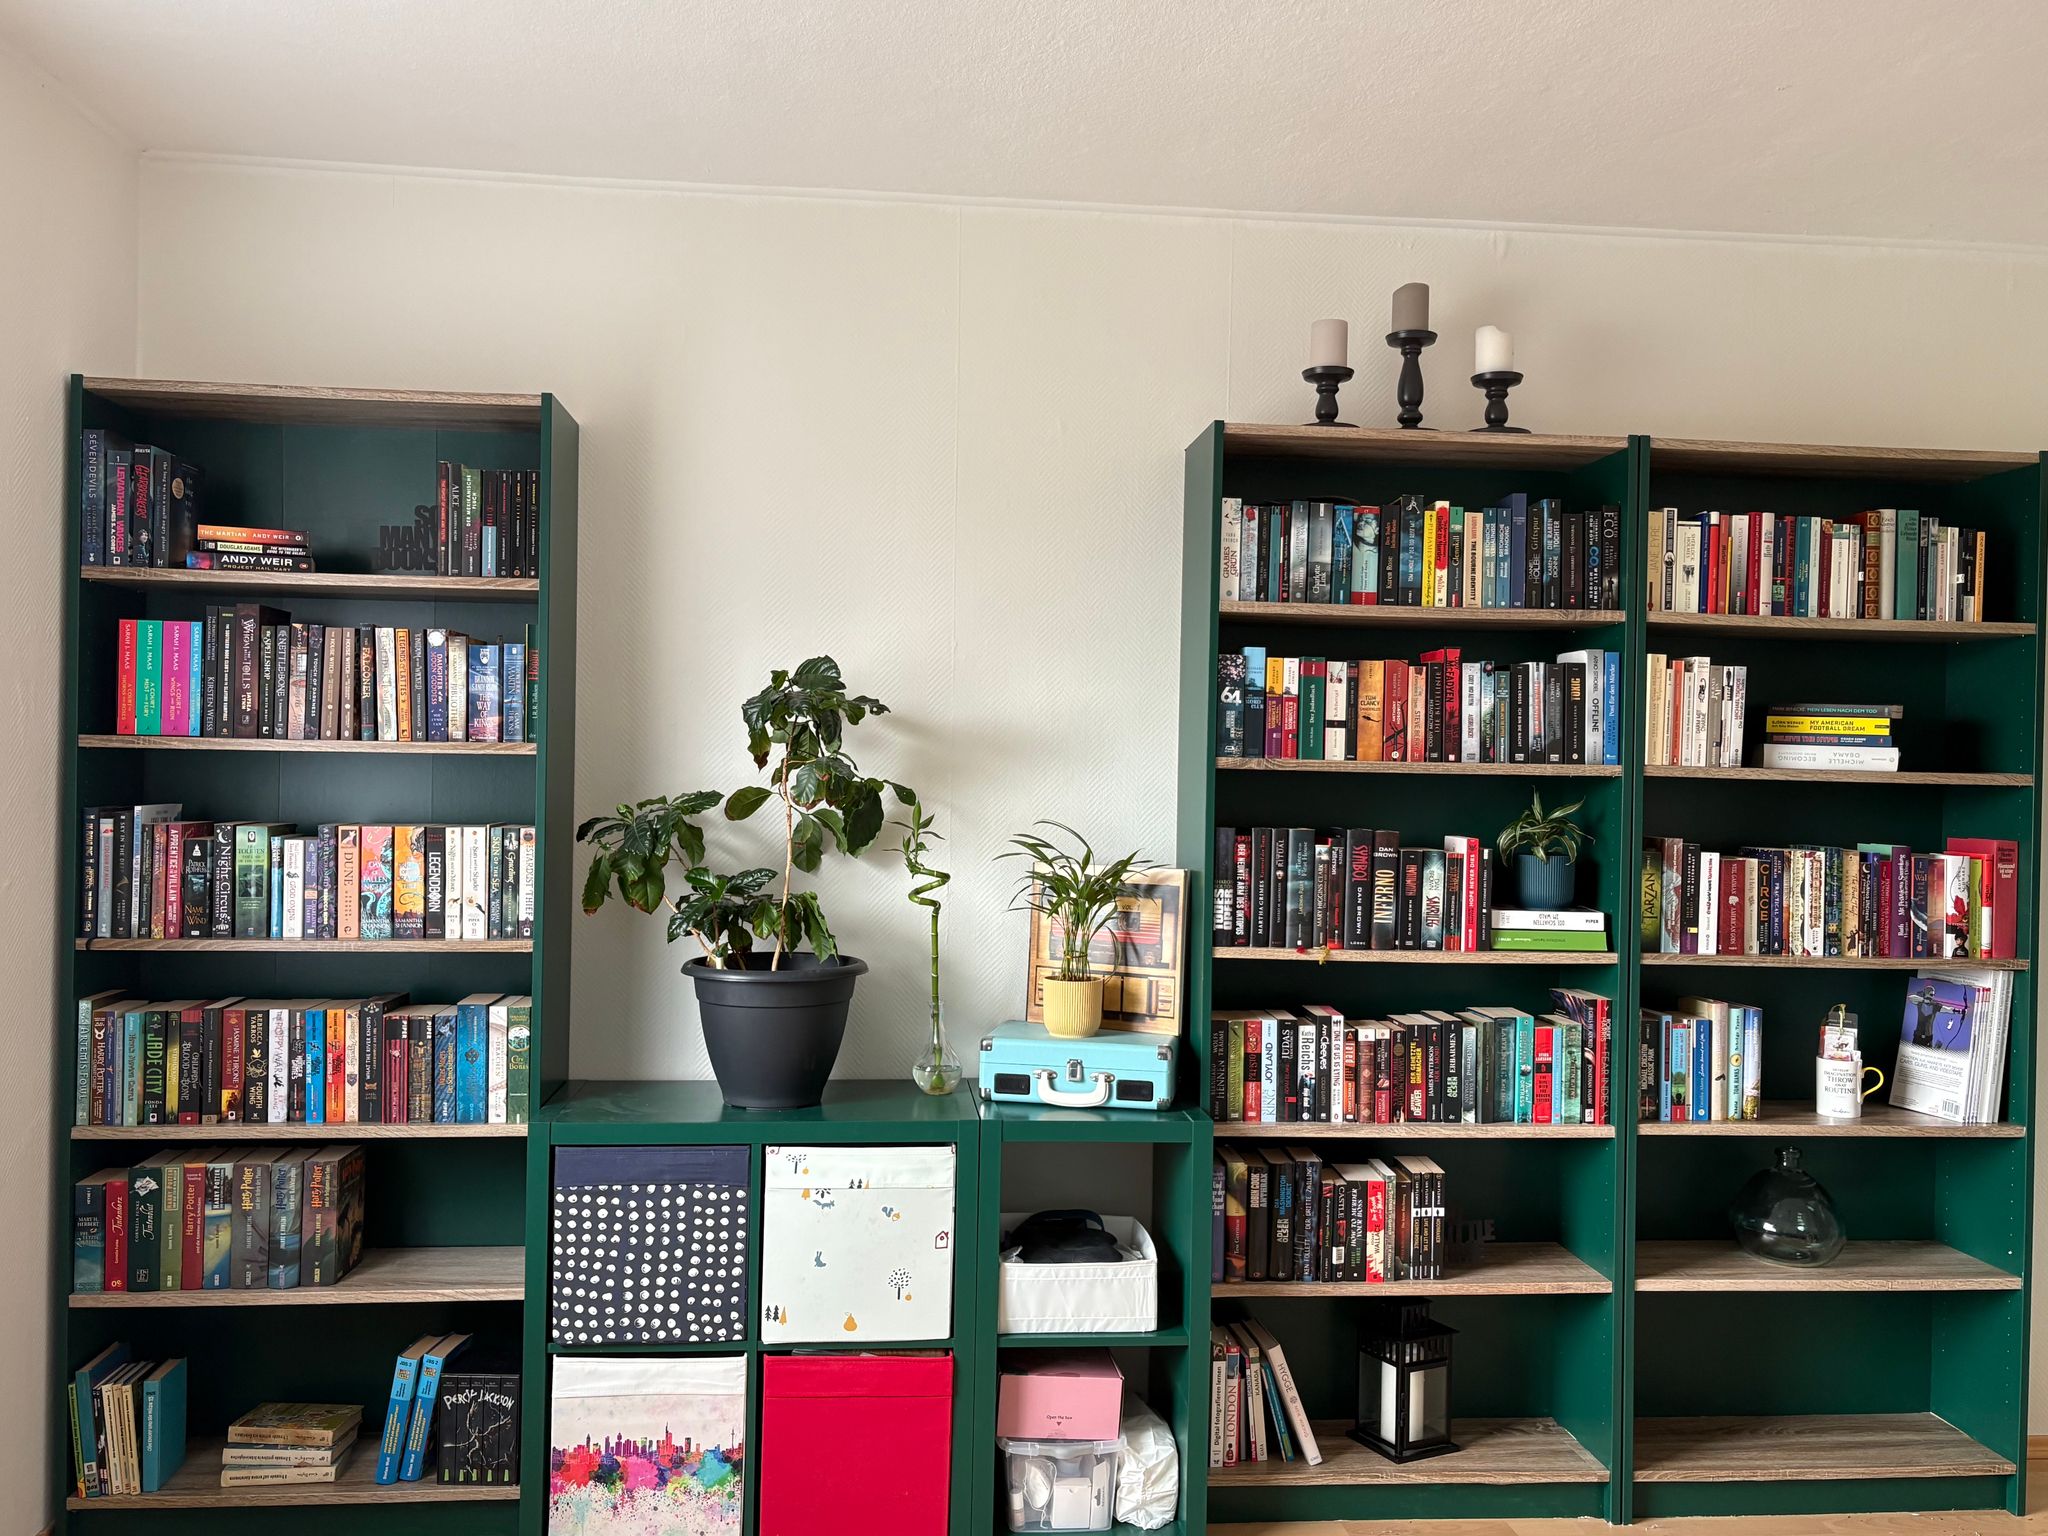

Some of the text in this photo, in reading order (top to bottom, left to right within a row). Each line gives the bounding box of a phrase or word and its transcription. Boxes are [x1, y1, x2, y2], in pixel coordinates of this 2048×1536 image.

[89, 434, 98, 499] SEVEN DEVILS
[116, 466, 126, 553] LEVIATHAN WAKES
[134, 464, 150, 519] GEARBREAKERS
[452, 484, 460, 507] ALICE
[216, 530, 247, 538] MARTIAN
[1530, 516, 1541, 551] Giftspur
[1603, 512, 1614, 538] ECO
[219, 543, 243, 551] DOUGLAS
[221, 555, 293, 567] ANDY WEIR
[1222, 546, 1231, 579] GRABES
[1452, 535, 1461, 566] Glennkill
[1312, 564, 1322, 594] Charlotte
[1319, 572, 1327, 588] Link
[1532, 554, 1541, 584] HOLBE
[264, 637, 272, 681] SPELLSHOP
[277, 638, 287, 672] NETTLE
[361, 647, 371, 699] FALCONER
[1220, 686, 1241, 704] 64
[1445, 660, 1454, 704] McFADYEN
[1570, 677, 1581, 702] TOXIC
[207, 676, 215, 732] KIRSTEN WEISS
[1592, 697, 1600, 733] OFFLINE
[1413, 710, 1421, 750] STEVE BERRY
[169, 829, 179, 901] APPRENTICE VILLAIN
[343, 852, 354, 886] DUNE
[491, 836, 500, 893] SKIN SEA
[503, 851, 516, 884] Graceling
[1277, 839, 1285, 868] RITUAL
[1331, 847, 1340, 876] Patterson
[1352, 844, 1369, 883] SYMBOL
[219, 846, 232, 919] Night Circus
[428, 852, 442, 913] LEGENDBORN
[524, 847, 533, 916] STARDUST THIEF
[1235, 843, 1246, 936] DER NEUNTE ARM DES OKTOPUS
[1373, 869, 1395, 925] INFERNO
[1643, 872, 1659, 920] TARZAN
[1759, 863, 1770, 921] CIRCE
[1214, 888, 1224, 931] TODES
[1223, 888, 1234, 931] OPFER
[1425, 895, 1441, 928] SAKRILEG
[233, 1028, 241, 1053] JASMINE
[275, 1022, 284, 1073] POPPY WAR
[1280, 1029, 1291, 1060] JUDAS
[1300, 1037, 1315, 1071] Reichs
[1319, 1023, 1330, 1070] Ann Cleeves
[1332, 1030, 1341, 1087] ONE LYING
[1448, 1032, 1457, 1073] ERBARMEN
[1466, 1043, 1474, 1076] McDermid
[1501, 1027, 1509, 1069] LABYRINTH
[79, 1027, 91, 1099] ARTEMIS FOWL
[96, 1042, 106, 1095] HARRY POTTER
[146, 1033, 163, 1095] JADE CITY
[180, 1041, 192, 1101] BLOOD BONE
[191, 1051, 200, 1083] CHILDREN
[1264, 1042, 1274, 1085] JOYLAND
[1601, 1051, 1610, 1107] FEAR INDEX
[255, 1082, 263, 1109] FOURTH
[1413, 1089, 1422, 1116] DEAVER
[1824, 1085, 1856, 1094] ROUTINE
[212, 1168, 221, 1210] HARRY POTTER
[240, 1167, 255, 1210] Harry Potter
[274, 1168, 286, 1210] Harry Potter
[309, 1165, 324, 1208] Harry Potter
[1259, 1173, 1268, 1208] ANTHRAX
[1337, 1186, 1346, 1219] CASTLE
[111, 1196, 124, 1237] Tintenherz
[185, 1183, 196, 1236] Harry Potter
[1253, 1369, 1261, 1396] KANADA
[1277, 1363, 1294, 1393] HYGGE
[444, 1389, 515, 1410] PERCY JACKSON
[1213, 1366, 1223, 1446] Digital fotografieren lernen
[1225, 1385, 1238, 1438] LONDON
